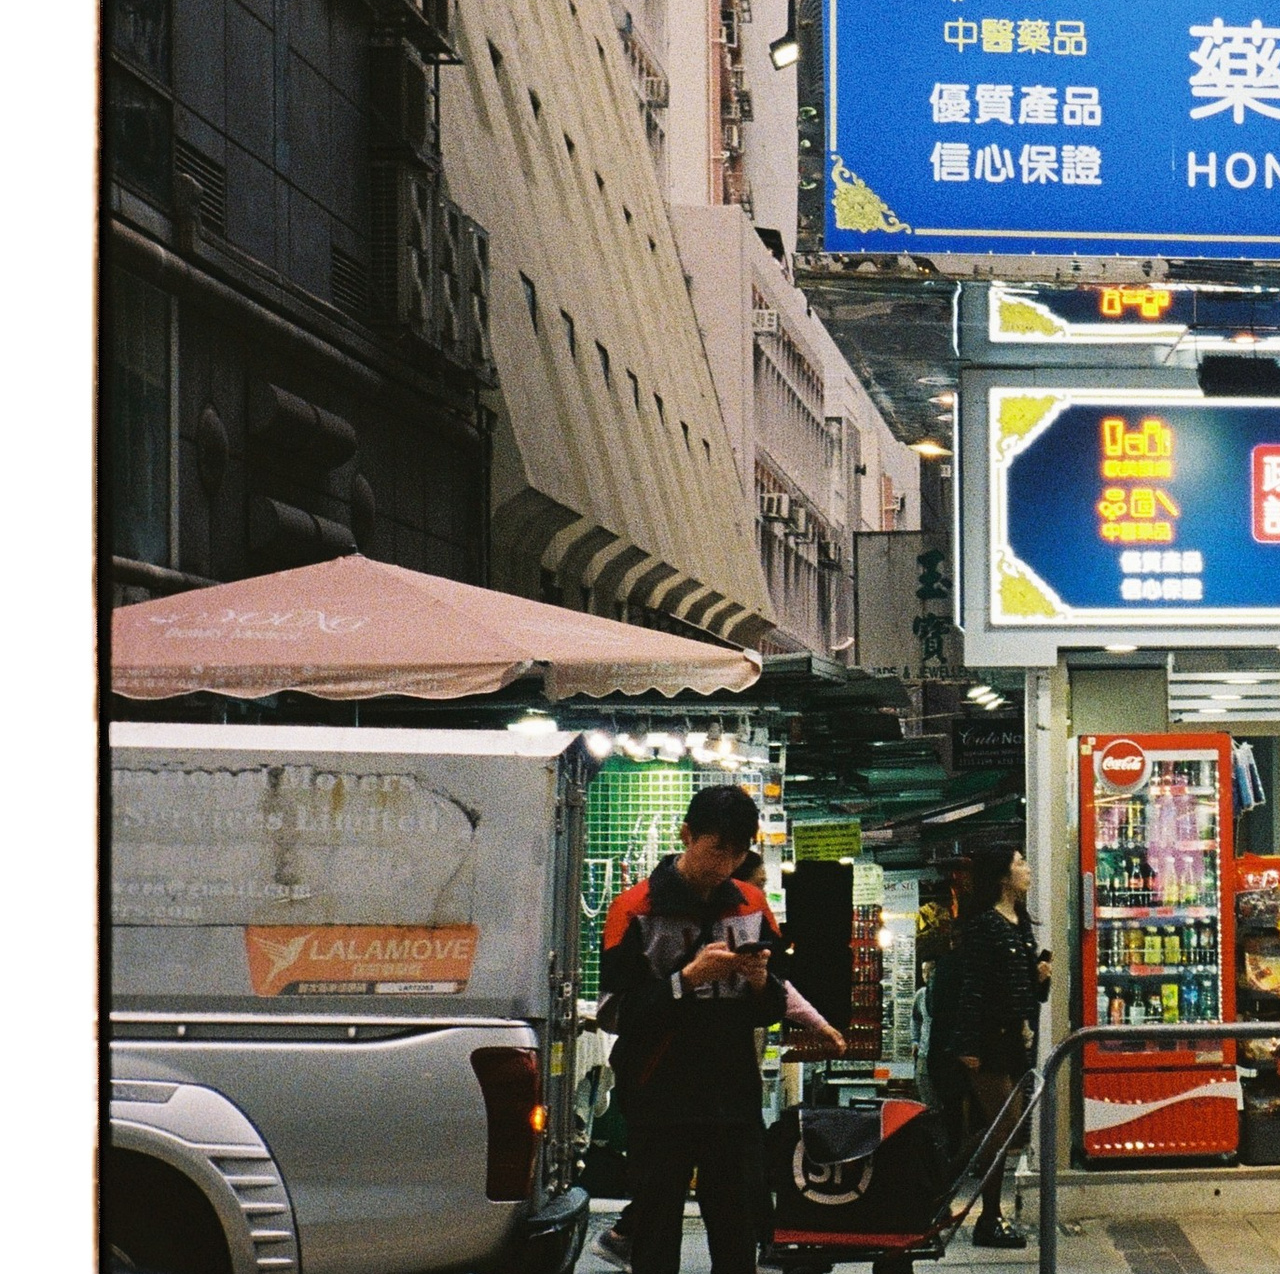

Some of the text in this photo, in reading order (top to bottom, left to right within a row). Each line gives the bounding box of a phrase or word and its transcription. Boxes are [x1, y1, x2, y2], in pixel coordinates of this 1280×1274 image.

[944, 18, 1088, 56] 中醫藥品
[930, 83, 1102, 127] 優質產品
[930, 142, 1102, 187] 信心保證
[309, 938, 471, 961] LALAMOVE
